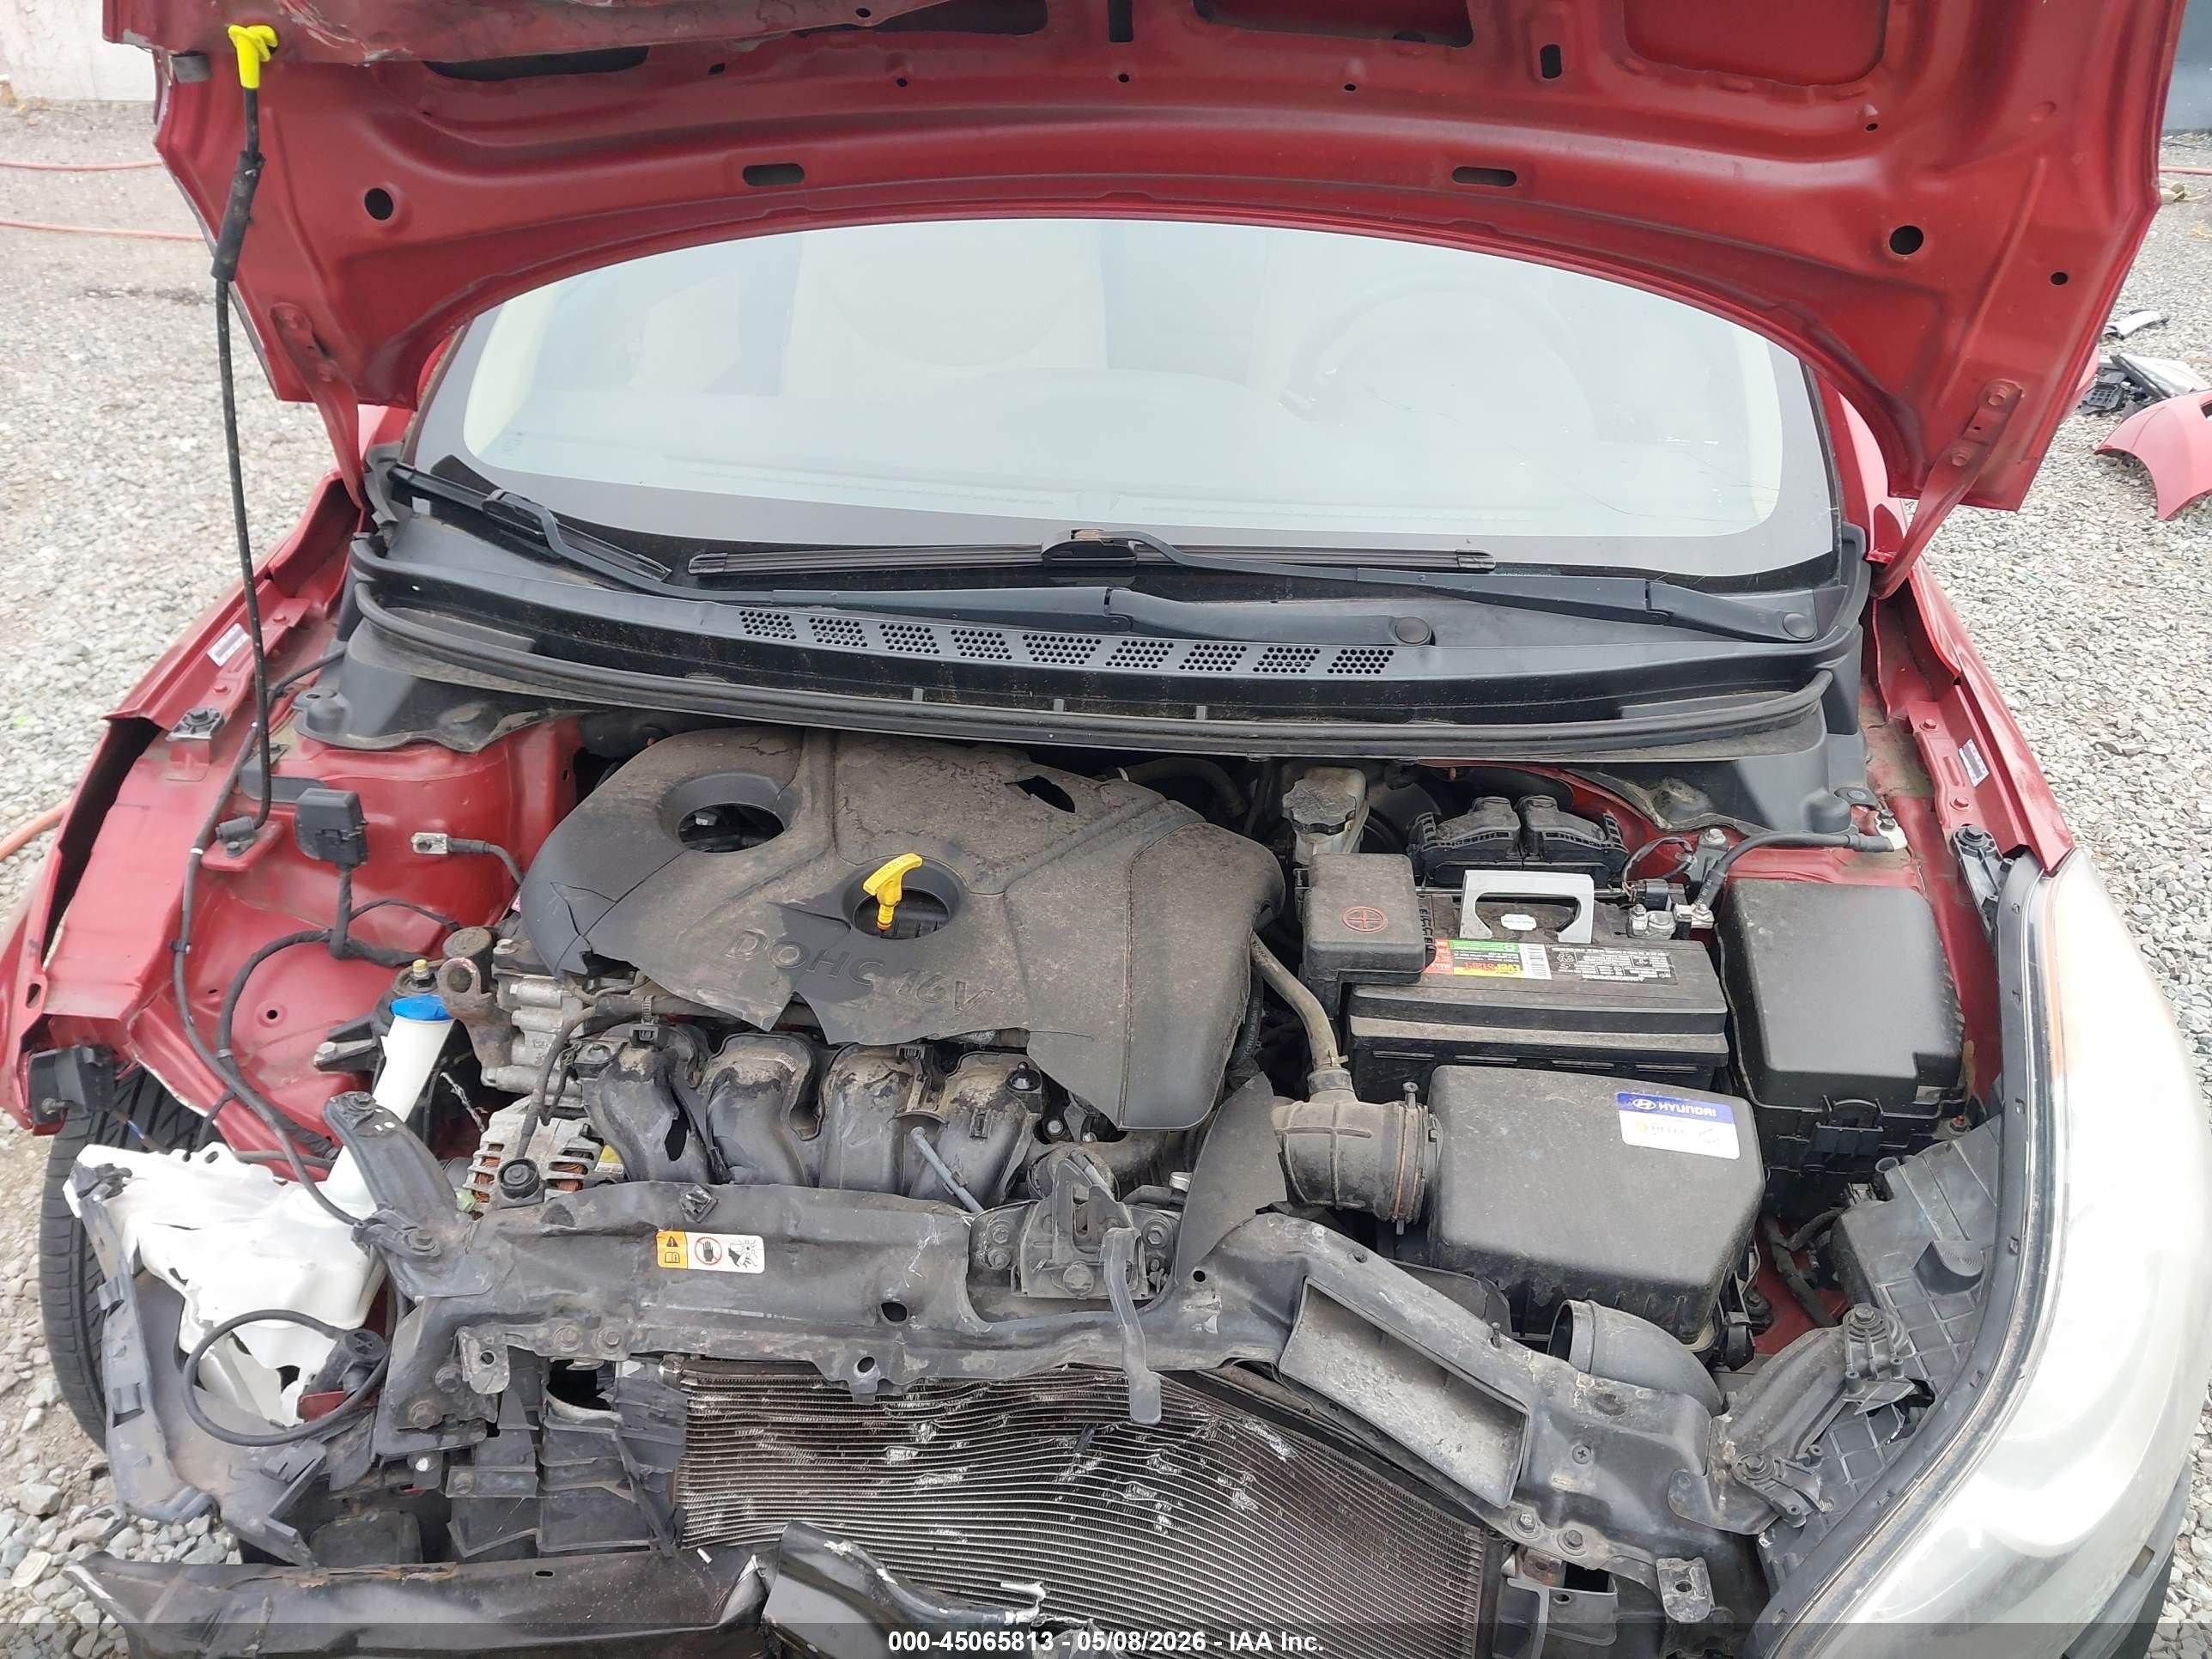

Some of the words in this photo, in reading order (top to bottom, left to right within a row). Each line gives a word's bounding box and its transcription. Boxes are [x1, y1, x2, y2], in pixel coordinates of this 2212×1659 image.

[724, 928, 885, 986] DOHC
[896, 968, 995, 1012] 16V
[1658, 1103, 1717, 1117] HYUNDAI
